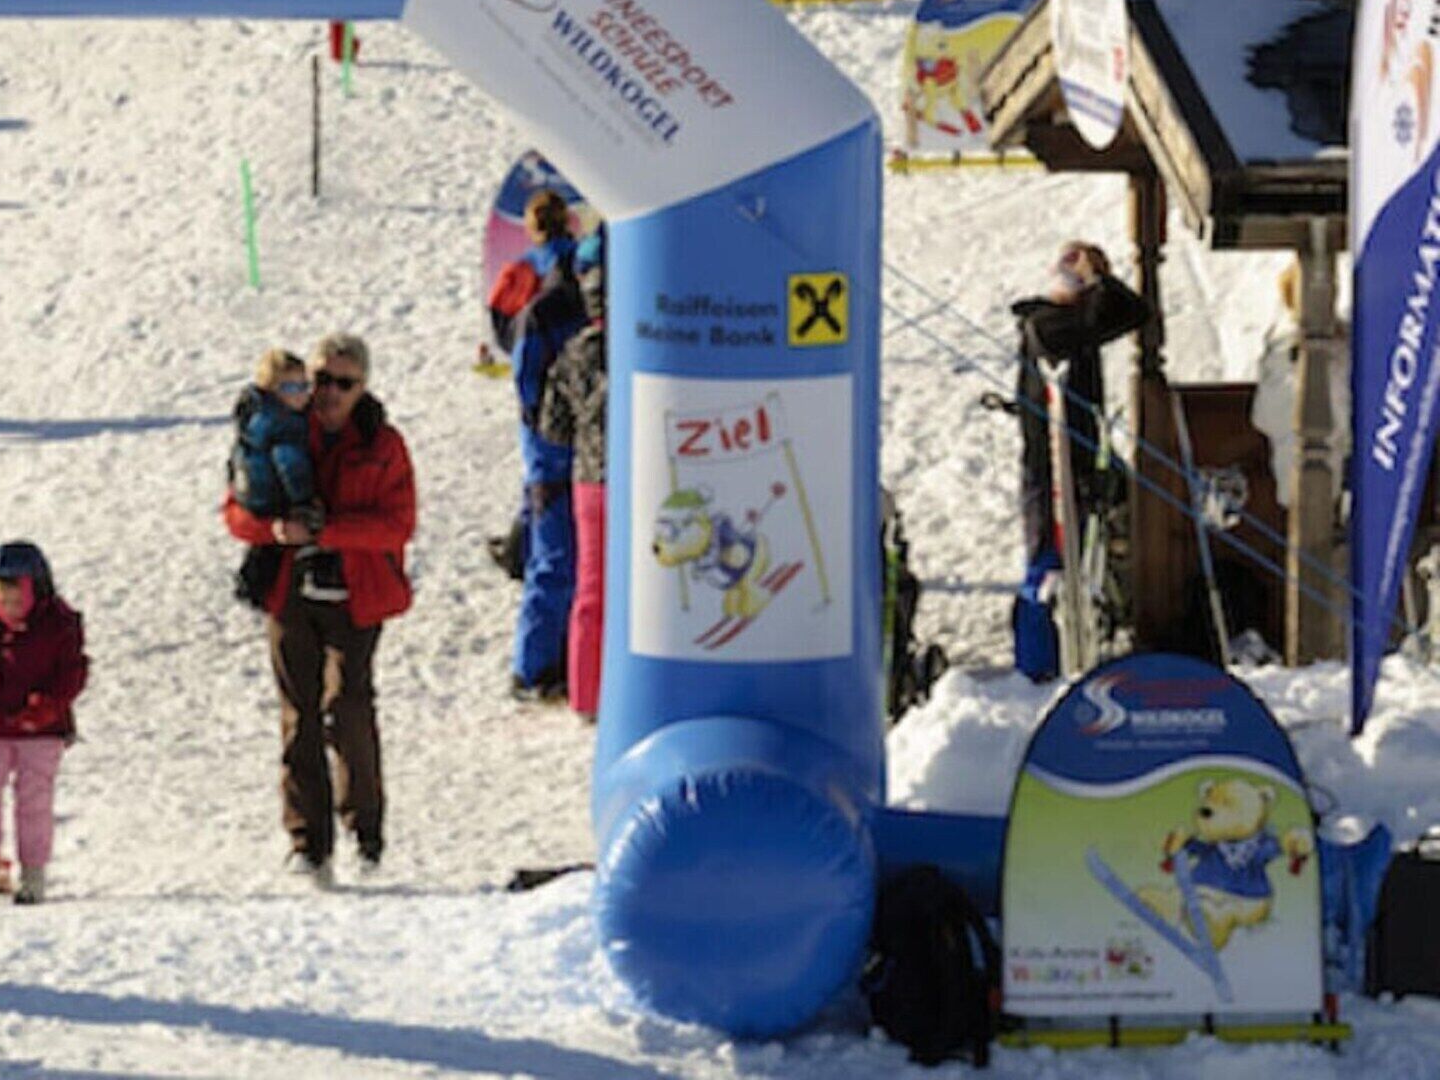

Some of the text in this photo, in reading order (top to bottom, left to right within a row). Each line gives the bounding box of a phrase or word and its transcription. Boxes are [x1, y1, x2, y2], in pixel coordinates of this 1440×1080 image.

[552, 10, 681, 142] WILDKOGEL
[591, 10, 683, 96] SCHULE
[656, 292, 778, 318] Raiffeisen
[710, 325, 774, 347] Bank
[676, 404, 771, 455] Ziel
